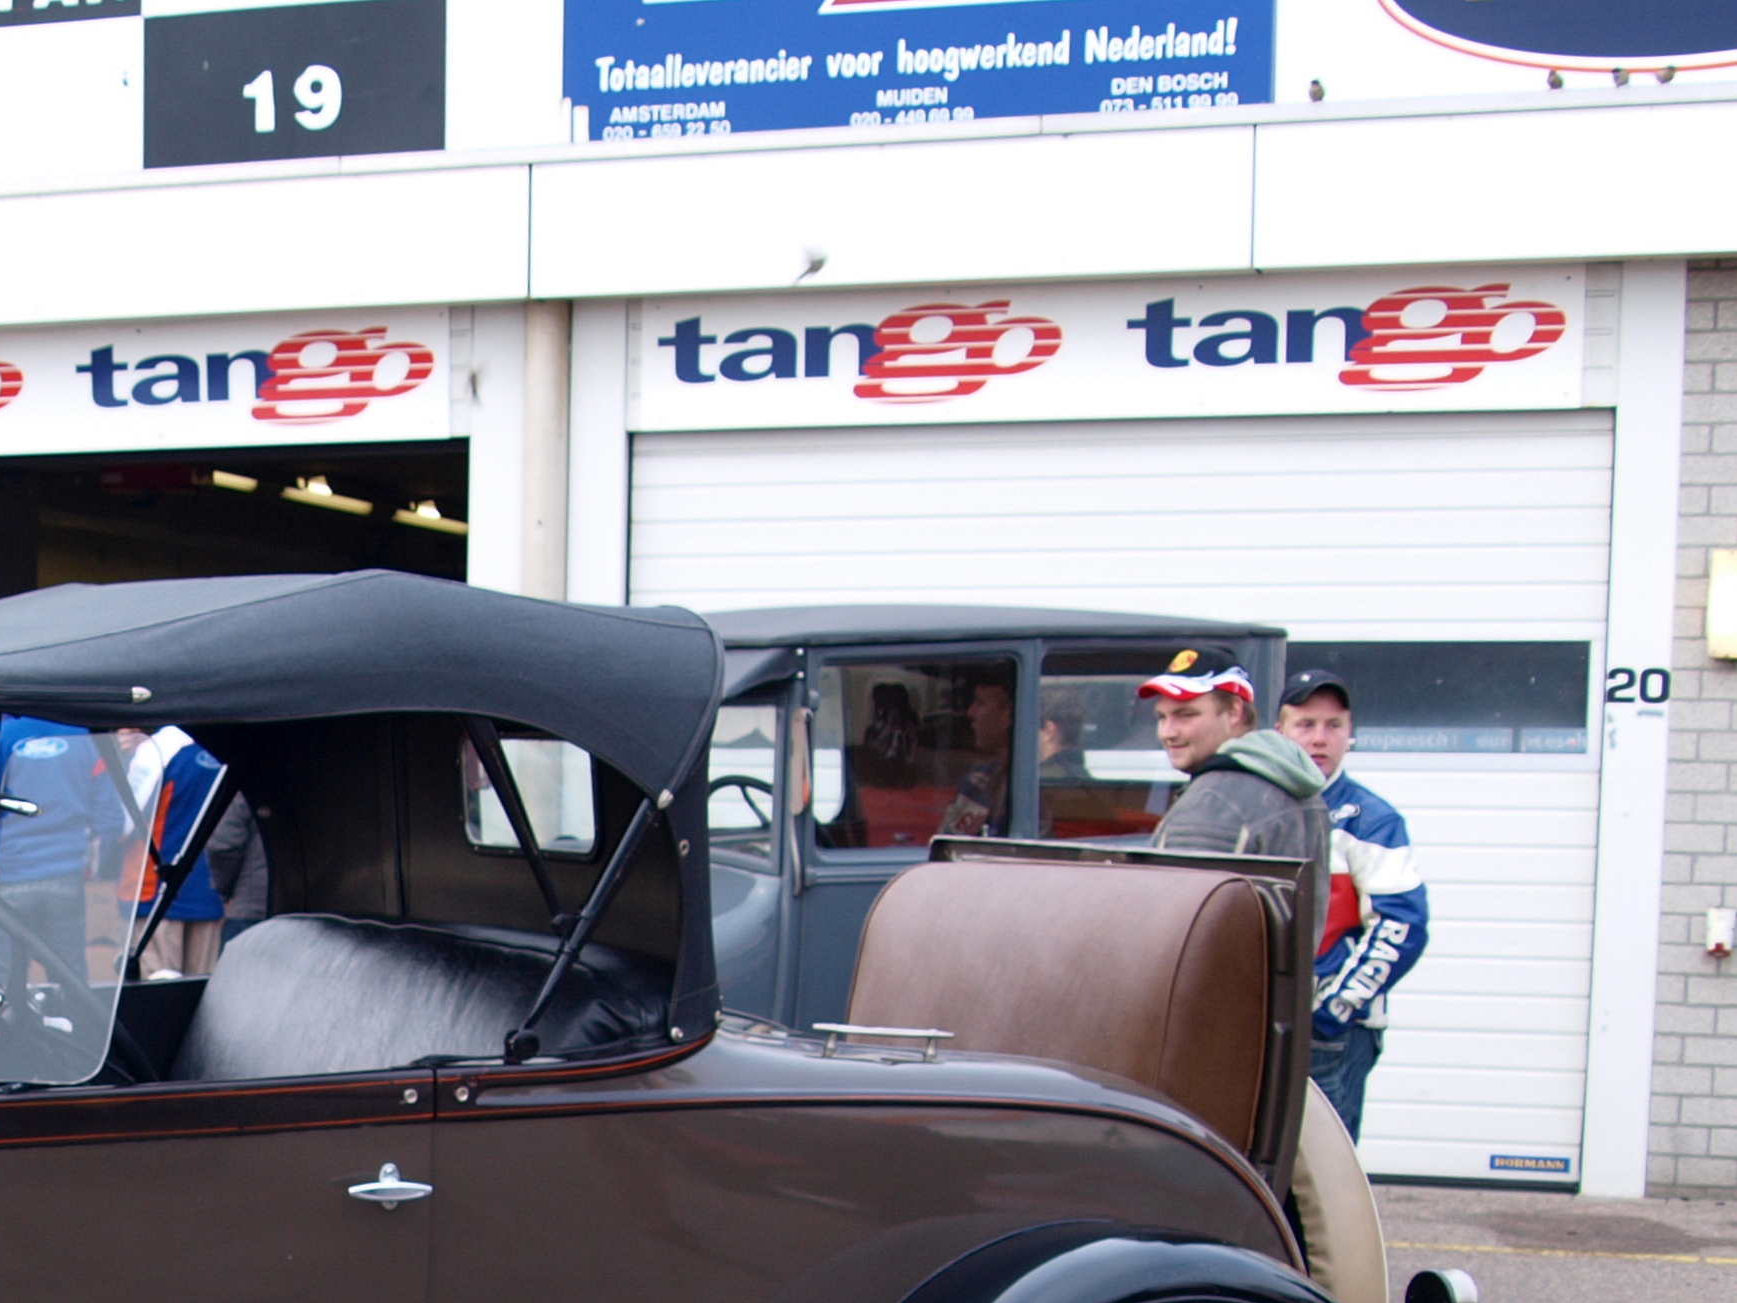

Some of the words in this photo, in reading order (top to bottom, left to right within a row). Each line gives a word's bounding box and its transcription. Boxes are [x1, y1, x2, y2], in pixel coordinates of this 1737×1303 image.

[595, 49, 812, 92] Totaalleverancier
[826, 51, 882, 78] voor
[896, 30, 1070, 81] hoogwerkend
[1084, 17, 1238, 64] Nederland!
[1111, 76, 1153, 95] DEN
[1157, 71, 1229, 93] BOSCH
[242, 64, 342, 133] 19
[609, 101, 726, 124] AMSTERDAM
[876, 86, 948, 108] MUIDEN
[76, 326, 434, 425] tango
[658, 299, 1063, 405] tango
[1126, 283, 1566, 392] tango
[1607, 667, 1671, 703] 20
[1328, 919, 1410, 1024] RACING
